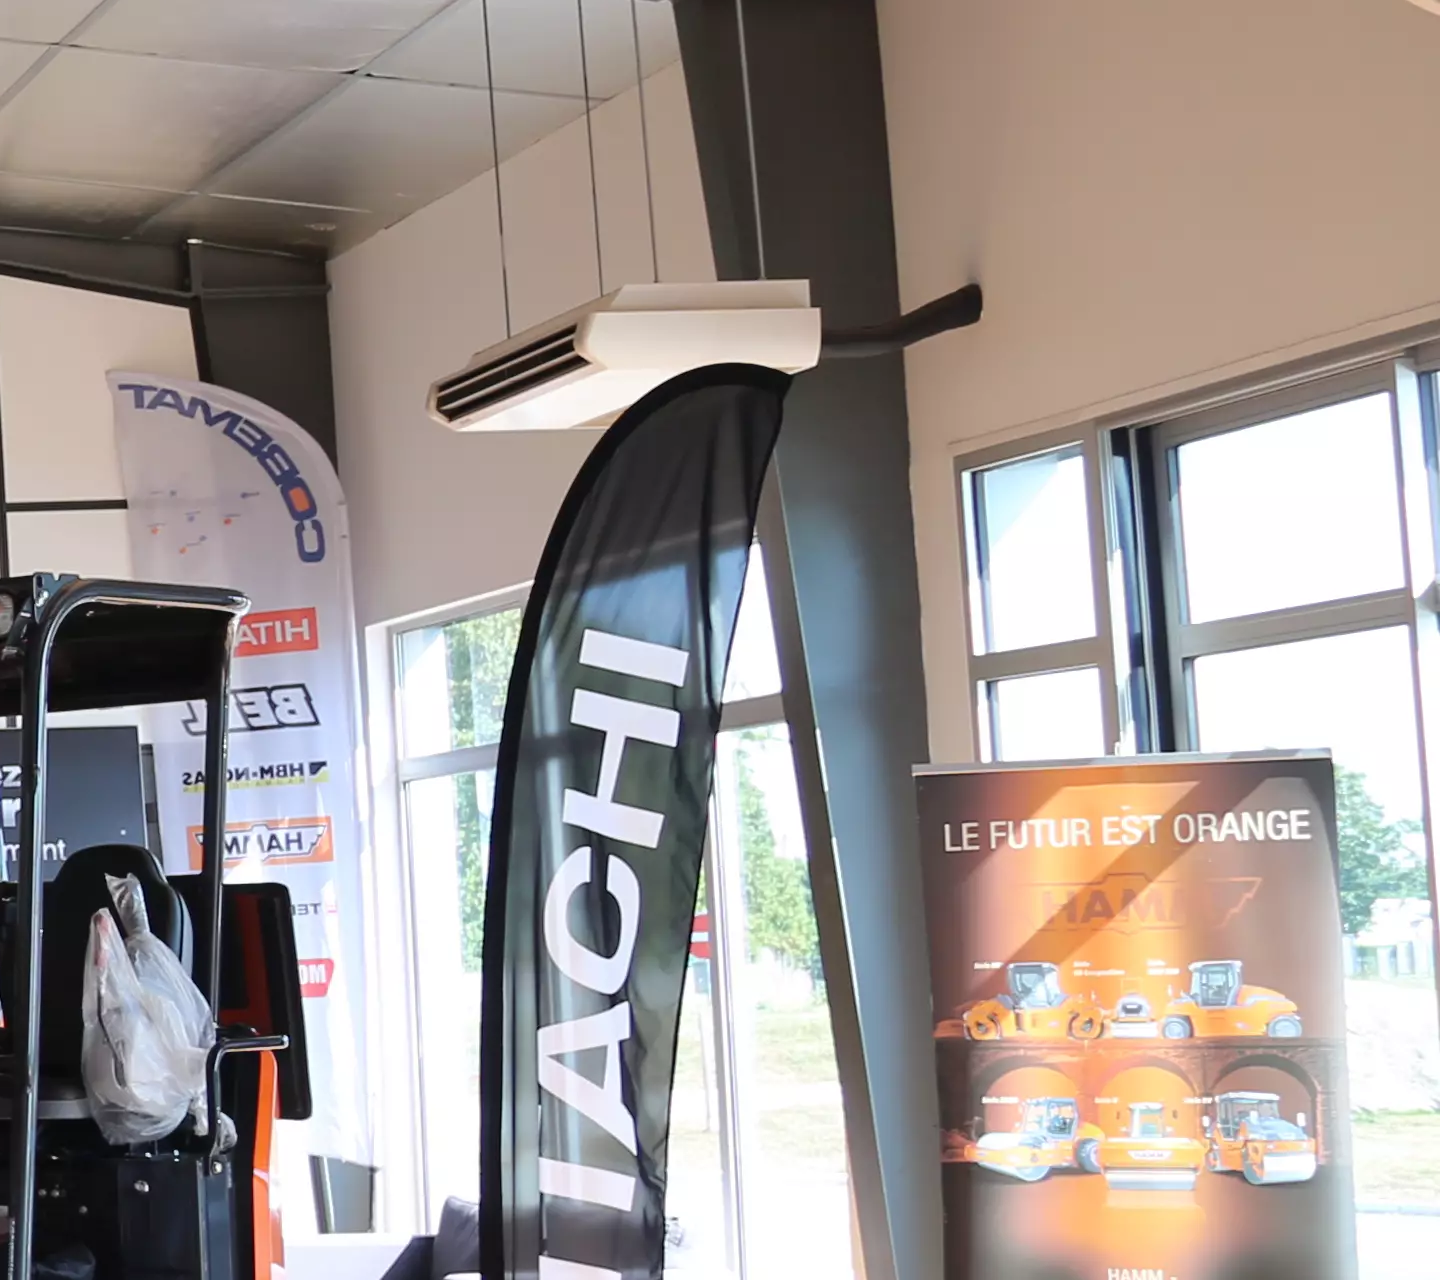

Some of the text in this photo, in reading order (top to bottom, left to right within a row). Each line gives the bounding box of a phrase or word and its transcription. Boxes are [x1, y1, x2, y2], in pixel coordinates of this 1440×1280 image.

[944, 809, 1312, 852] LE FUTUR EST ORANGE
